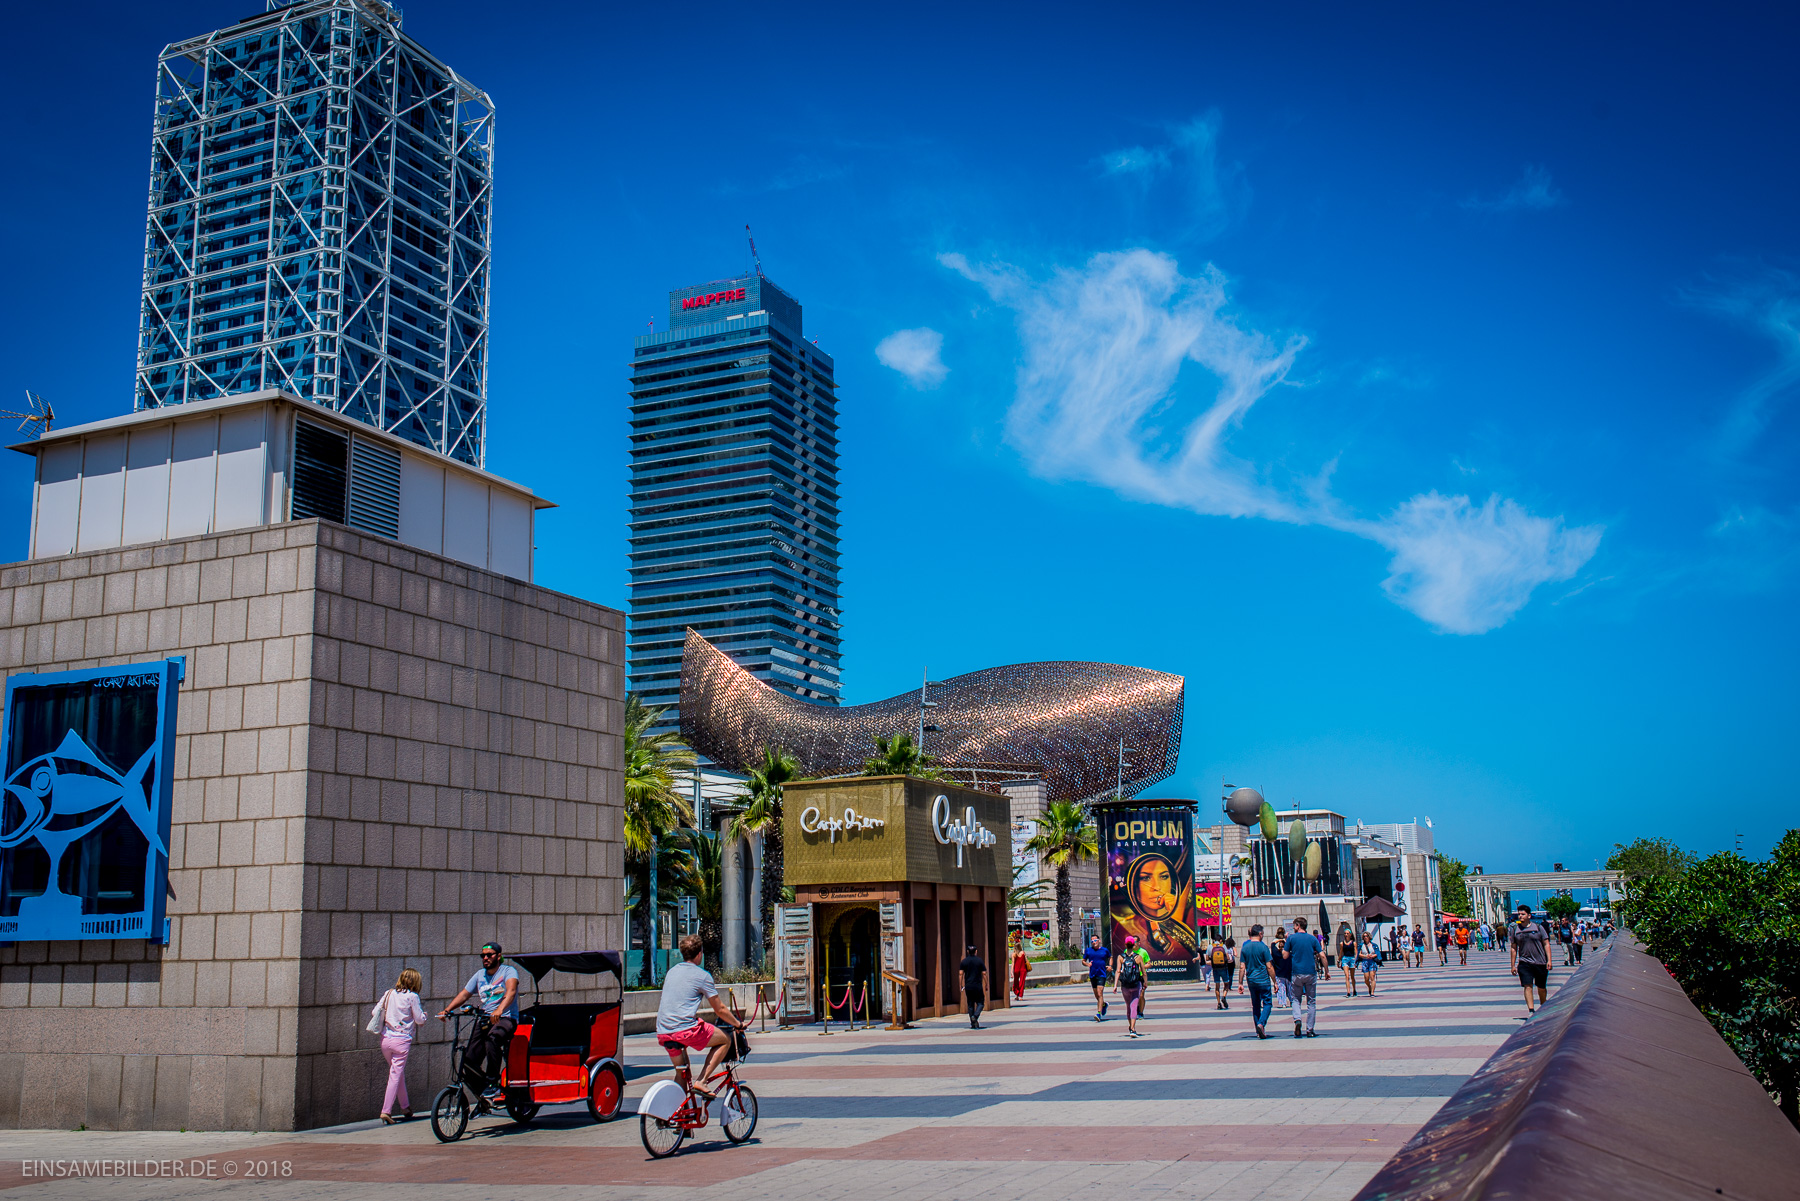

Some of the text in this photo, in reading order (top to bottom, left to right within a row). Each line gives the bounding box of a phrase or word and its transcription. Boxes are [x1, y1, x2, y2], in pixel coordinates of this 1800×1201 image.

[682, 287, 745, 309] MAPFRE
[800, 806, 843, 844] Carpe
[1114, 820, 1184, 840] OPIUM
